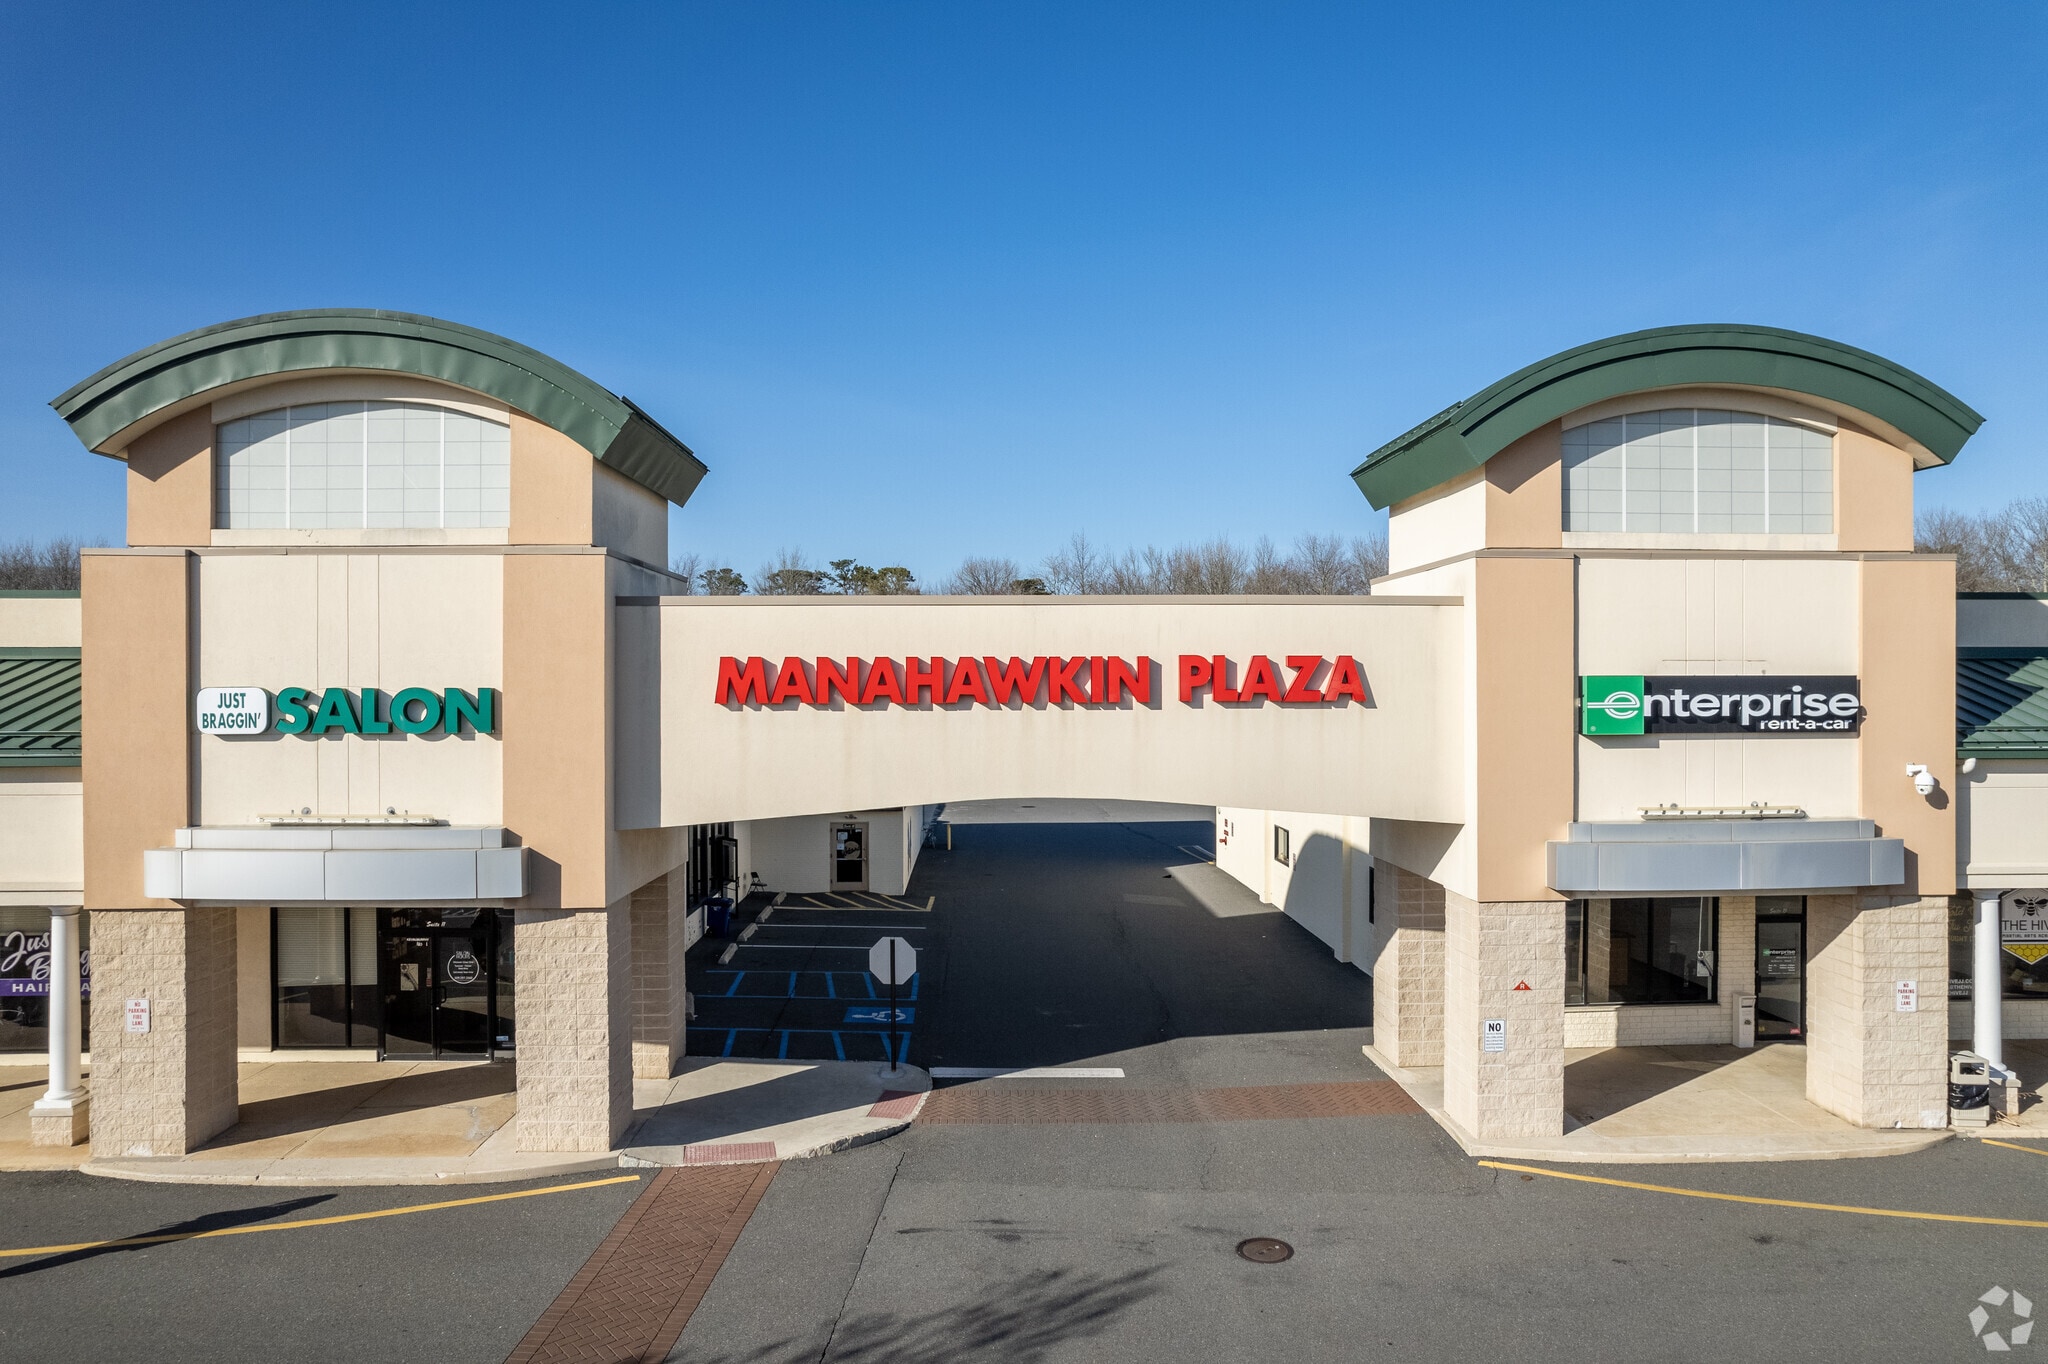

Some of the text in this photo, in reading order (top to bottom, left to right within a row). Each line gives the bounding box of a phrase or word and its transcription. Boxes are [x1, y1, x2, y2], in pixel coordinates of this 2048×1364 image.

[714, 654, 1367, 706] MANAHAWKIN PLAZA
[217, 692, 246, 709] JUST
[1587, 685, 1860, 726] enterprise
[275, 687, 494, 734] SALON
[202, 712, 261, 729] BRAGGIN'
[1760, 717, 1852, 730] rent-a-car
[2002, 919, 2027, 931] THE
[1, 931, 51, 972] Jus
[1488, 1022, 1502, 1032] NO
